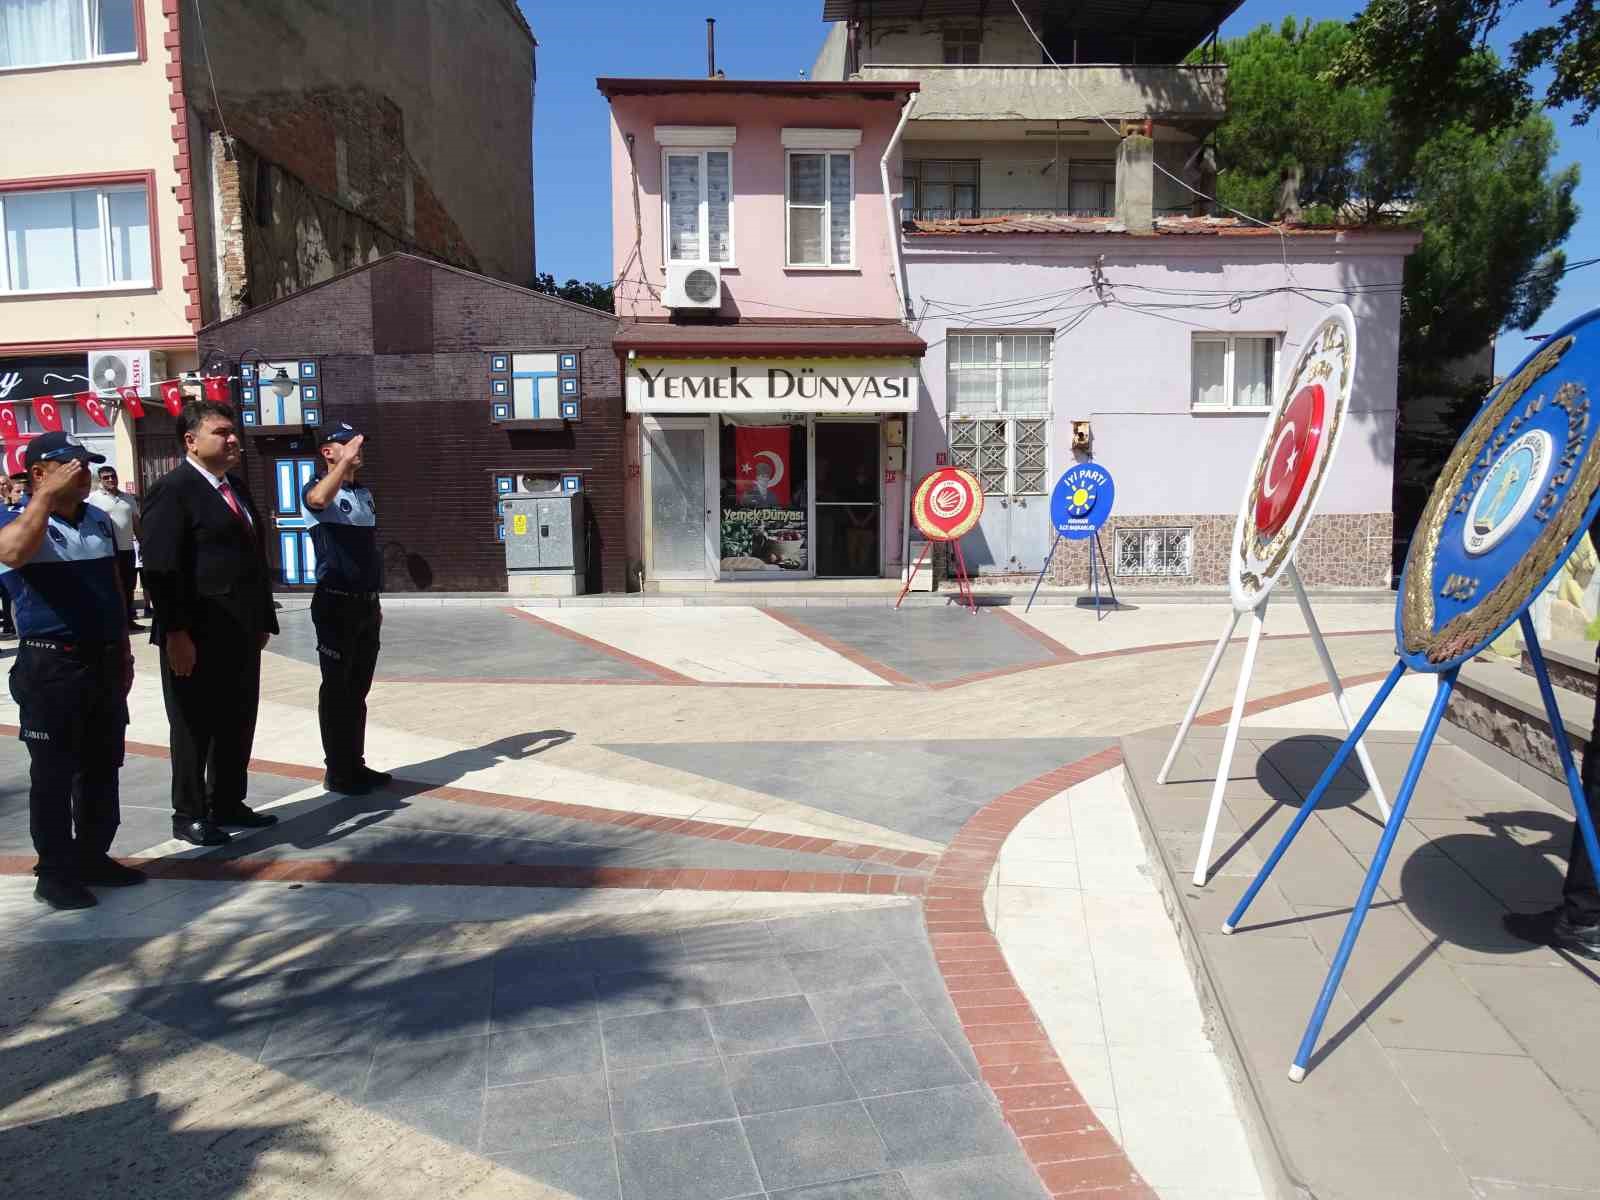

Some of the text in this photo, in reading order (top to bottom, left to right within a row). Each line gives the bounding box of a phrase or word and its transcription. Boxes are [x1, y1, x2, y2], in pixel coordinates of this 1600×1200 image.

[638, 366, 909, 406] YEMEK DÜNYASI
[723, 508, 760, 521] Yemek
